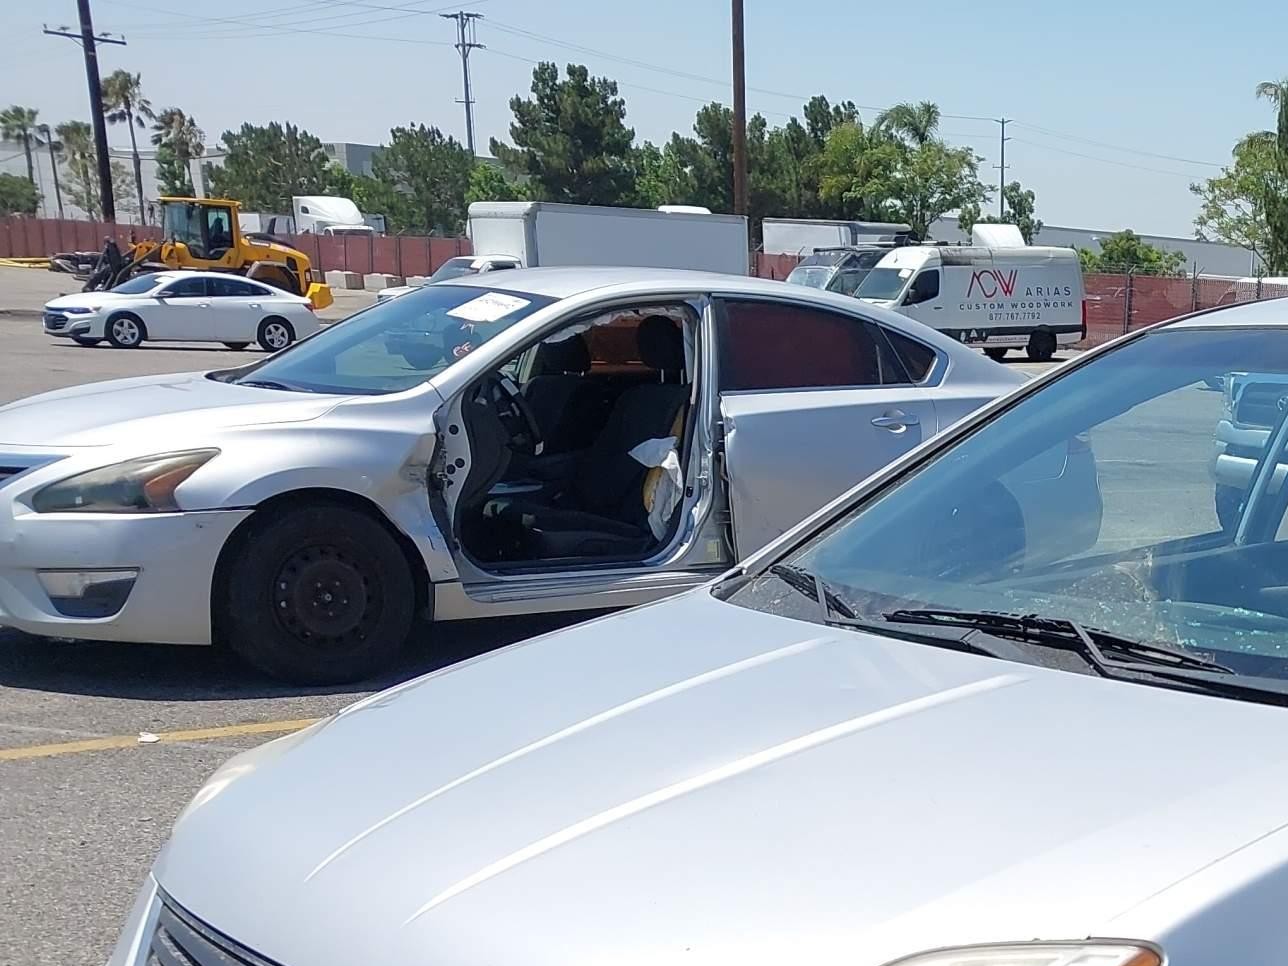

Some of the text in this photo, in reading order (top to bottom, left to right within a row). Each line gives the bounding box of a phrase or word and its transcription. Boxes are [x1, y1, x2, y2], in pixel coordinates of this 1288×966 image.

[1025, 286, 1072, 297] ARIAS
[959, 301, 1073, 311] CUSTOM WOODWORK
[988, 311, 1041, 321] 877.767.7792
